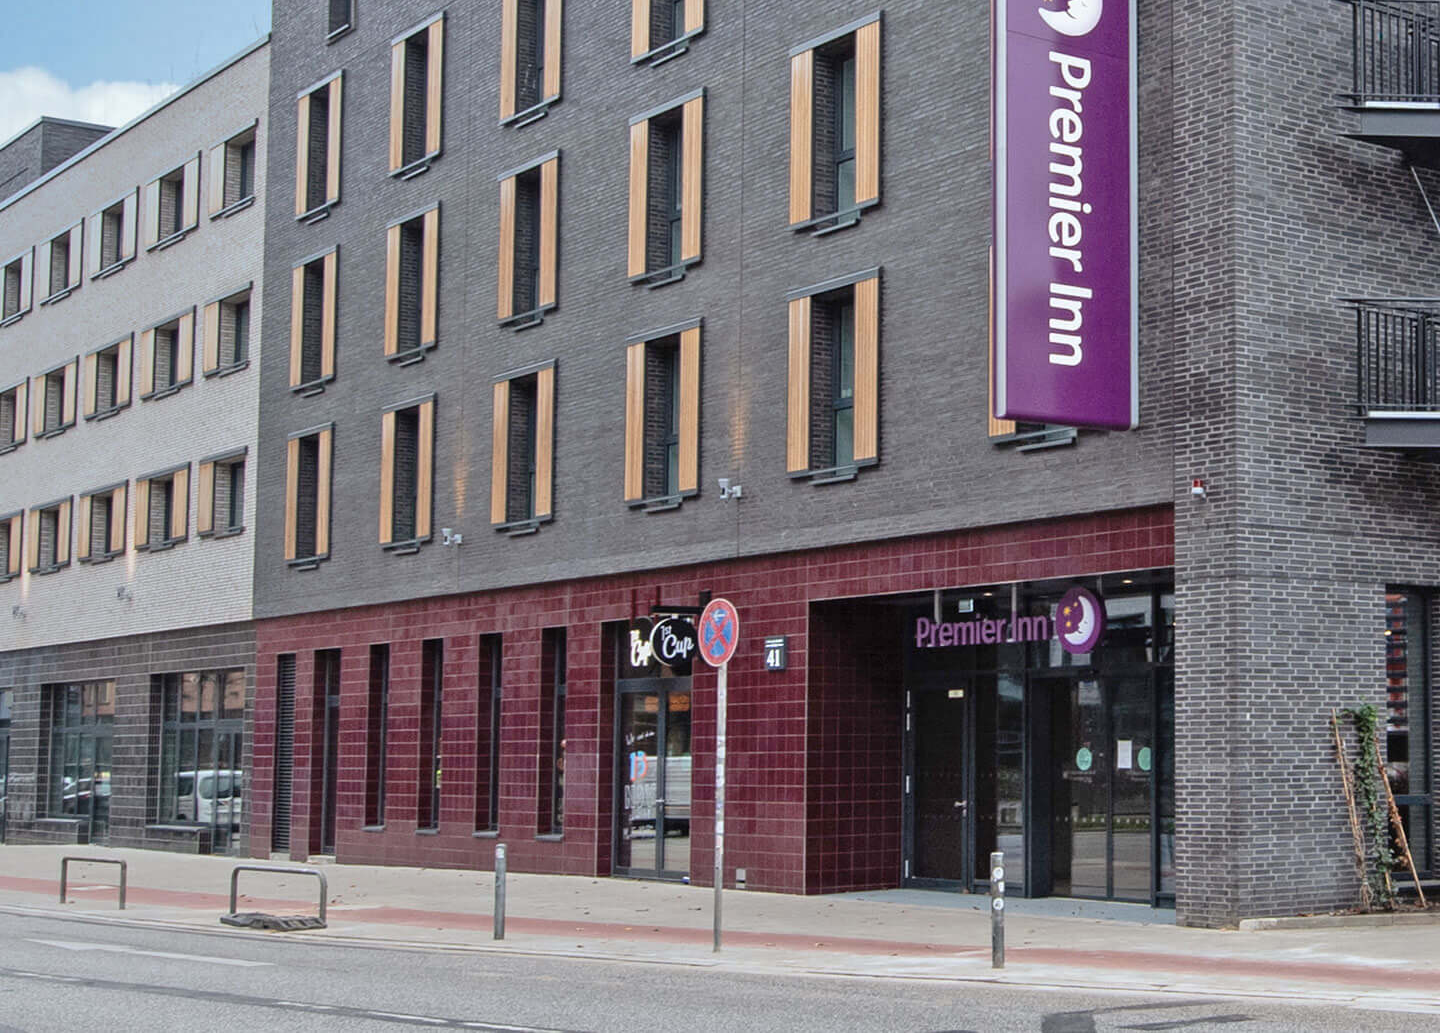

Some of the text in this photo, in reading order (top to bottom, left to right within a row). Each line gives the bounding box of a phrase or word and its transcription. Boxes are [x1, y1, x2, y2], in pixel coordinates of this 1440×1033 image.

[1049, 51, 1093, 366] Premier Inn
[916, 611, 1048, 648] Premier Inn
[662, 633, 694, 659] Cup
[766, 649, 780, 667] 41
